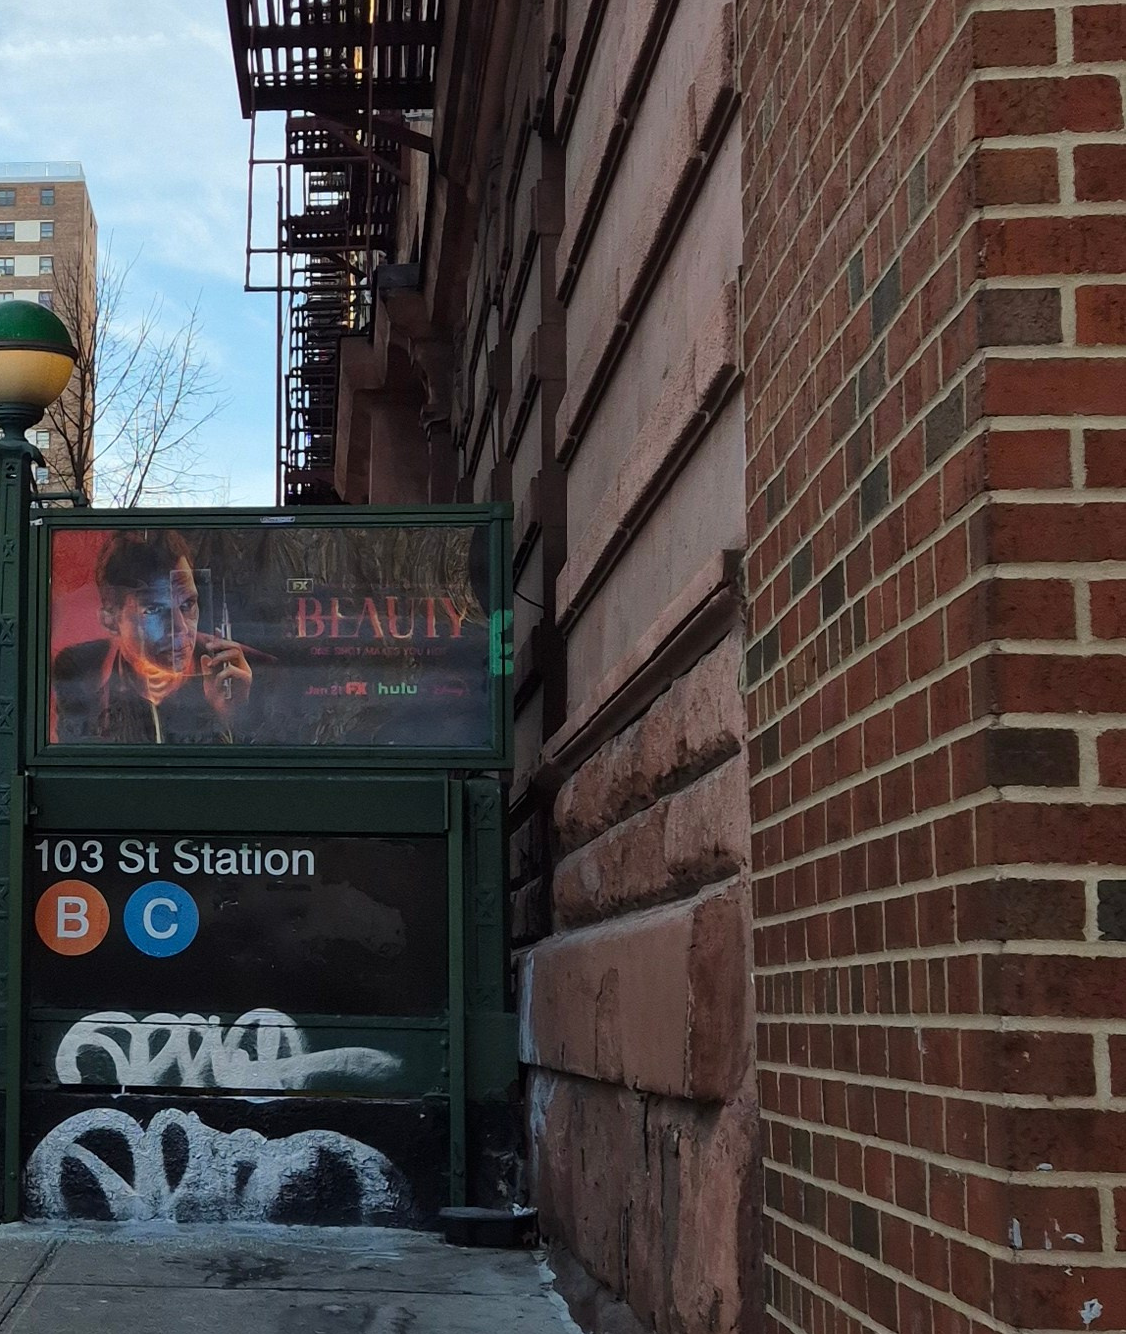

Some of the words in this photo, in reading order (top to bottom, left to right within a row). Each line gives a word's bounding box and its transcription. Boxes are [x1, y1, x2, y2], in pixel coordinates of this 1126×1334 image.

[295, 595, 468, 639] BEAUTY
[403, 646, 423, 656] YOU
[345, 681, 368, 695] FX
[378, 681, 418, 695] hulu
[34, 839, 105, 873] 103
[117, 838, 160, 874] St
[173, 839, 316, 876] Station
[56, 896, 90, 939] B
[142, 897, 179, 940] C
